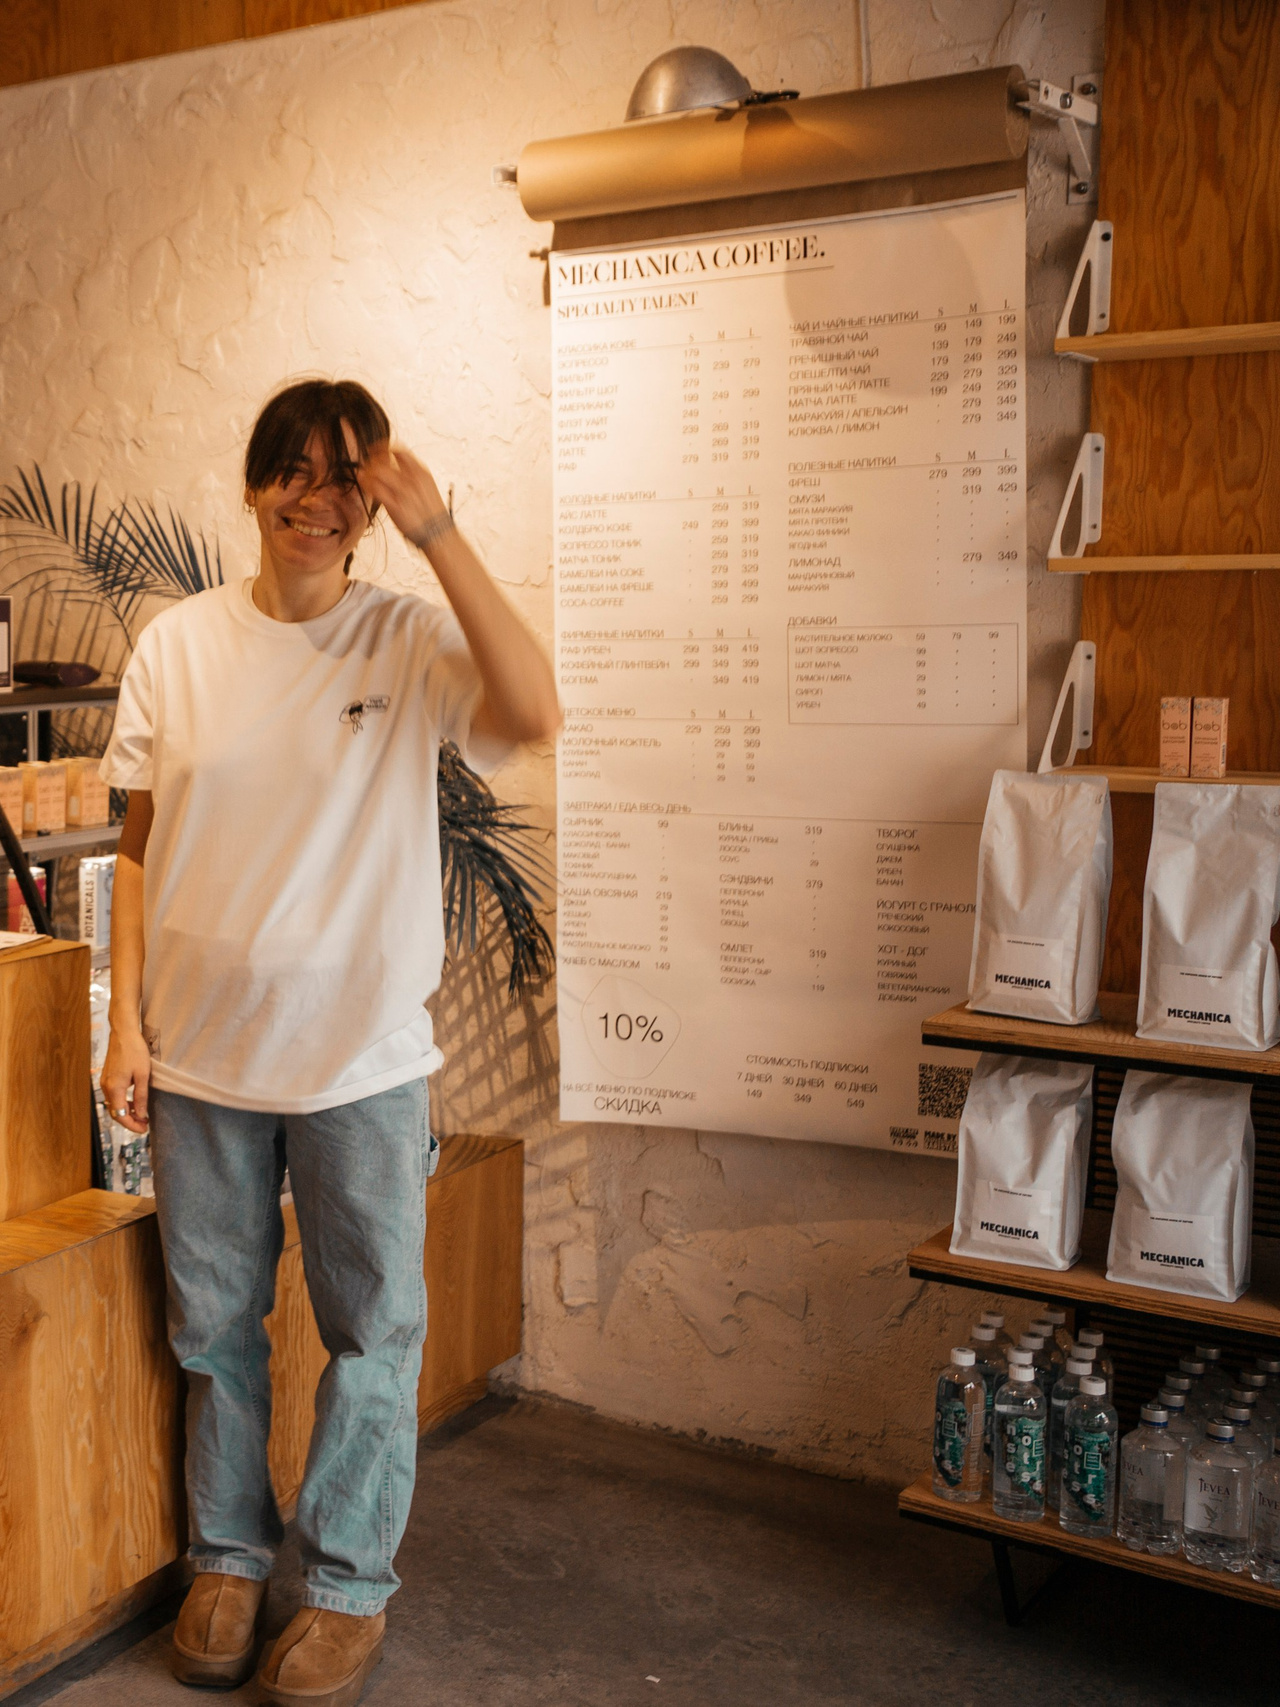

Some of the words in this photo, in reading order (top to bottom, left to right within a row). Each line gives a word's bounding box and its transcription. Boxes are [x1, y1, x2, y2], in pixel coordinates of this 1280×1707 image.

[558, 251, 707, 286] MECHANICA
[713, 235, 825, 269] COFFEE.
[558, 297, 635, 318] SPECIALTY
[641, 291, 698, 311] TALENT
[790, 334, 845, 347] ТРАВЯНОЙ
[847, 332, 868, 342] ЧАЙ
[934, 323, 946, 332] 99
[965, 318, 982, 329] 149
[998, 315, 1016, 325] 199
[558, 343, 608, 353] КЛАССИКА
[610, 339, 636, 349] КОФЕ
[789, 350, 856, 365] ГРЕЧИШНЫЙ
[858, 348, 879, 358] ЧАЙ
[932, 340, 948, 350] 139
[964, 336, 982, 347] 179
[997, 333, 1016, 343] 249
[789, 368, 848, 381] СПЕШЕЛТИ
[850, 365, 870, 376] ЧАЙ
[931, 356, 948, 366] 179
[964, 353, 982, 364] 249
[997, 349, 1016, 360] 299
[789, 382, 833, 395] ПРЯНЫЙ
[836, 380, 857, 391] ЧАЙ
[859, 378, 890, 389] ЛАТТЕ
[930, 371, 949, 382] 229
[963, 369, 982, 379] 279
[997, 365, 1017, 375] 329
[789, 397, 823, 408] МАТЧА
[825, 394, 857, 405] ЛАТТЕ
[930, 385, 947, 396] 199
[962, 383, 981, 394] 249
[997, 380, 1016, 391] 299
[789, 408, 843, 423] МАРАКУЙЯ
[852, 405, 908, 418] АПЕЛЬСИН
[962, 398, 981, 408] 279
[997, 395, 1016, 406] 349
[789, 425, 833, 437] КЛЮКВА
[842, 422, 880, 433] ЛИМОН
[962, 413, 981, 424] 279
[997, 410, 1016, 421] 349
[558, 462, 577, 471] РАФ
[682, 455, 699, 463] 279
[712, 452, 728, 461] 319
[743, 450, 759, 460] 379
[788, 459, 845, 473] ПОЛЕЗНЫЕ
[848, 456, 896, 468] НАПИТКИ
[789, 477, 820, 487] ФРЕШ
[929, 469, 947, 479] 279
[962, 467, 981, 478] 299
[997, 465, 1017, 476] 399
[789, 494, 825, 504] СМУЗИ
[962, 485, 981, 495] 319
[997, 483, 1017, 493] 429
[559, 509, 578, 520] АЙС
[580, 509, 607, 519] ЛАТТЕ
[712, 502, 729, 512] 259
[742, 501, 759, 510] 319
[607, 522, 633, 532] КОФЕ
[682, 521, 699, 529] 249
[712, 519, 728, 528] 299
[742, 518, 759, 527] 399
[789, 557, 841, 569] ЛИМОНАД
[962, 553, 982, 563] 279
[998, 551, 1017, 561] 349
[788, 583, 829, 593] МАРАКУЙЯ
[788, 616, 837, 626] ДОБАВКИ
[561, 646, 580, 655] РАФ
[582, 646, 611, 654] УРБЕЧ
[683, 645, 699, 654] 299
[712, 645, 729, 653] 349
[741, 644, 758, 653] 419
[561, 660, 614, 669] КОФЕЙНЫЙ
[616, 660, 669, 669] ГЛИНТВЕЙН
[683, 660, 700, 669] 299
[712, 660, 729, 668] 349
[742, 660, 759, 668] 399
[561, 676, 599, 684] БОГЕМА
[713, 676, 729, 684] 349
[742, 676, 759, 684] 419
[685, 725, 701, 734] 229
[714, 725, 730, 734] 259
[744, 726, 760, 735] 299
[563, 737, 617, 747] МОЛОЧНЫЙ
[620, 738, 661, 748] КОКТЕЛЬ
[714, 739, 730, 748] 299
[744, 739, 760, 748] 369
[563, 802, 612, 812] ЗАВТРАКИ
[619, 803, 637, 812] ЕДА
[640, 803, 664, 812] ВЕСЬ
[666, 803, 691, 814] ДЕНЬ
[564, 817, 604, 827] СЫРНИК
[657, 820, 669, 829] 99
[718, 822, 754, 832] БЛИНЫ
[805, 826, 822, 835] 319
[877, 828, 918, 838] ТВОРОГ
[876, 843, 920, 852] СГУЩЕНКА
[719, 874, 773, 886] СЭНДВИЧИ
[806, 879, 823, 889] 379
[876, 878, 903, 886] БАНАН
[564, 888, 591, 896] КАША
[593, 889, 638, 898] ОВСЯНАЯ
[656, 891, 672, 901] 219
[84, 880, 94, 938] BOTANICALS
[877, 912, 924, 922] ГРЕЧЕСКИЙ
[877, 924, 930, 934] КОКОСОВЫЙ
[720, 943, 754, 954] ОМЛЕТ
[809, 949, 826, 959] 319
[878, 945, 898, 954] ХОТ
[907, 946, 928, 957] ДОГ
[589, 958, 595, 967] С
[598, 959, 640, 969] МАСЛОМ
[655, 962, 670, 971] 149
[878, 983, 950, 994] ВЕГЕТАРИАНСКИЙ
[995, 973, 1051, 989] MECHANICA
[1167, 1008, 1231, 1024] MECHANICA
[599, 1012, 664, 1043] 10%
[746, 1054, 808, 1068] СТОИМОСТЬ
[811, 1060, 869, 1074] ПОДПИСКИ
[737, 1072, 742, 1081] 7
[745, 1072, 772, 1083] ДНЕЙ
[783, 1076, 794, 1086] 30
[796, 1077, 824, 1089] ДНЕЙ
[835, 1081, 847, 1091] 60
[849, 1082, 878, 1093] ДНЕЙ
[596, 1085, 625, 1094] МЕНЮ
[627, 1087, 642, 1095] ПО
[644, 1088, 697, 1100] ПОДПИСКЕ
[747, 1089, 762, 1098] 149
[794, 1093, 811, 1103] 349
[847, 1099, 864, 1108] 549
[594, 1096, 662, 1114] СКИДКА
[980, 1221, 1039, 1240] MECHANICA
[1140, 1251, 1204, 1268] MECHANICA
[1258, 1491, 1280, 1510] JEVE
